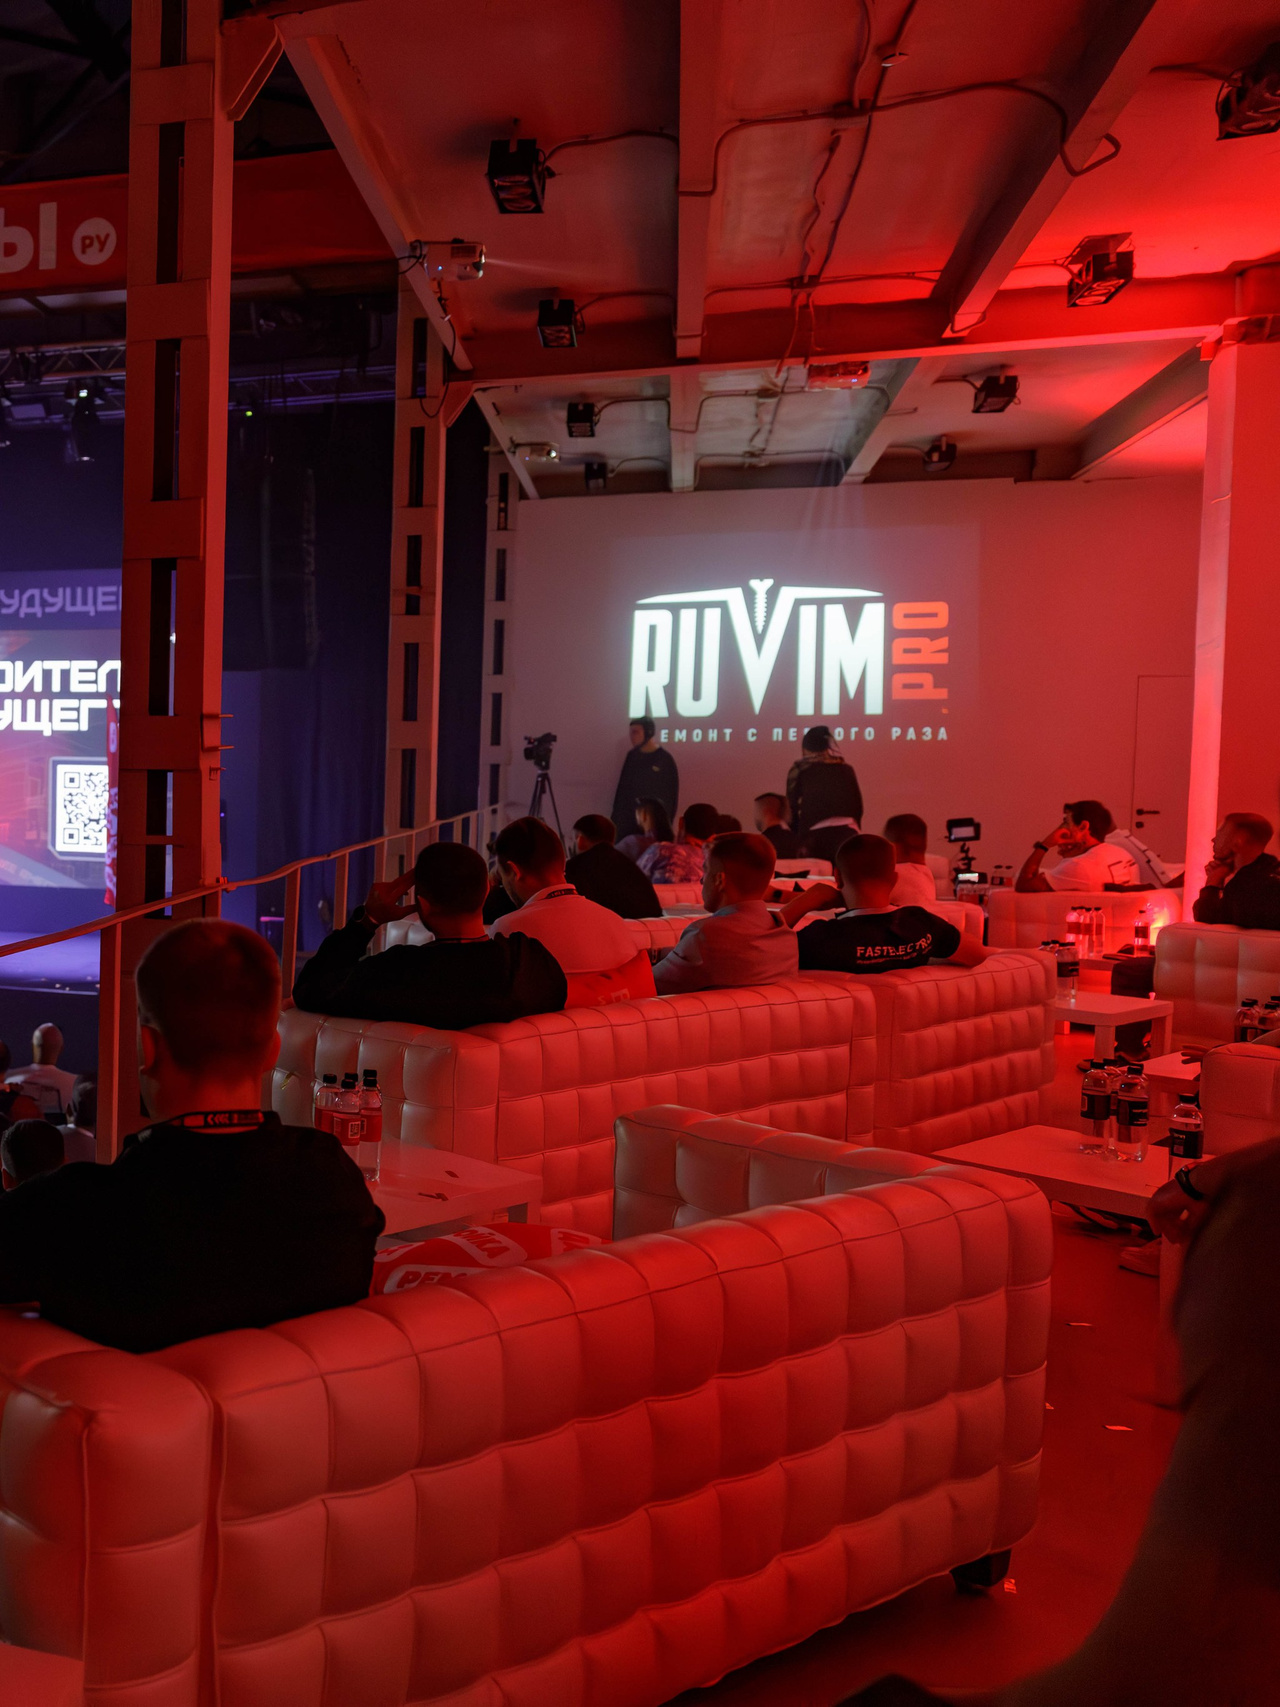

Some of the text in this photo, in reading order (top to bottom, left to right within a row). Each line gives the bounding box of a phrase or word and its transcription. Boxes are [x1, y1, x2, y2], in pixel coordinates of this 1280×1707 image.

[629, 579, 885, 718] RUVIM
[660, 726, 948, 743] ЕМОНТ С ПЕОГО РАЗА
